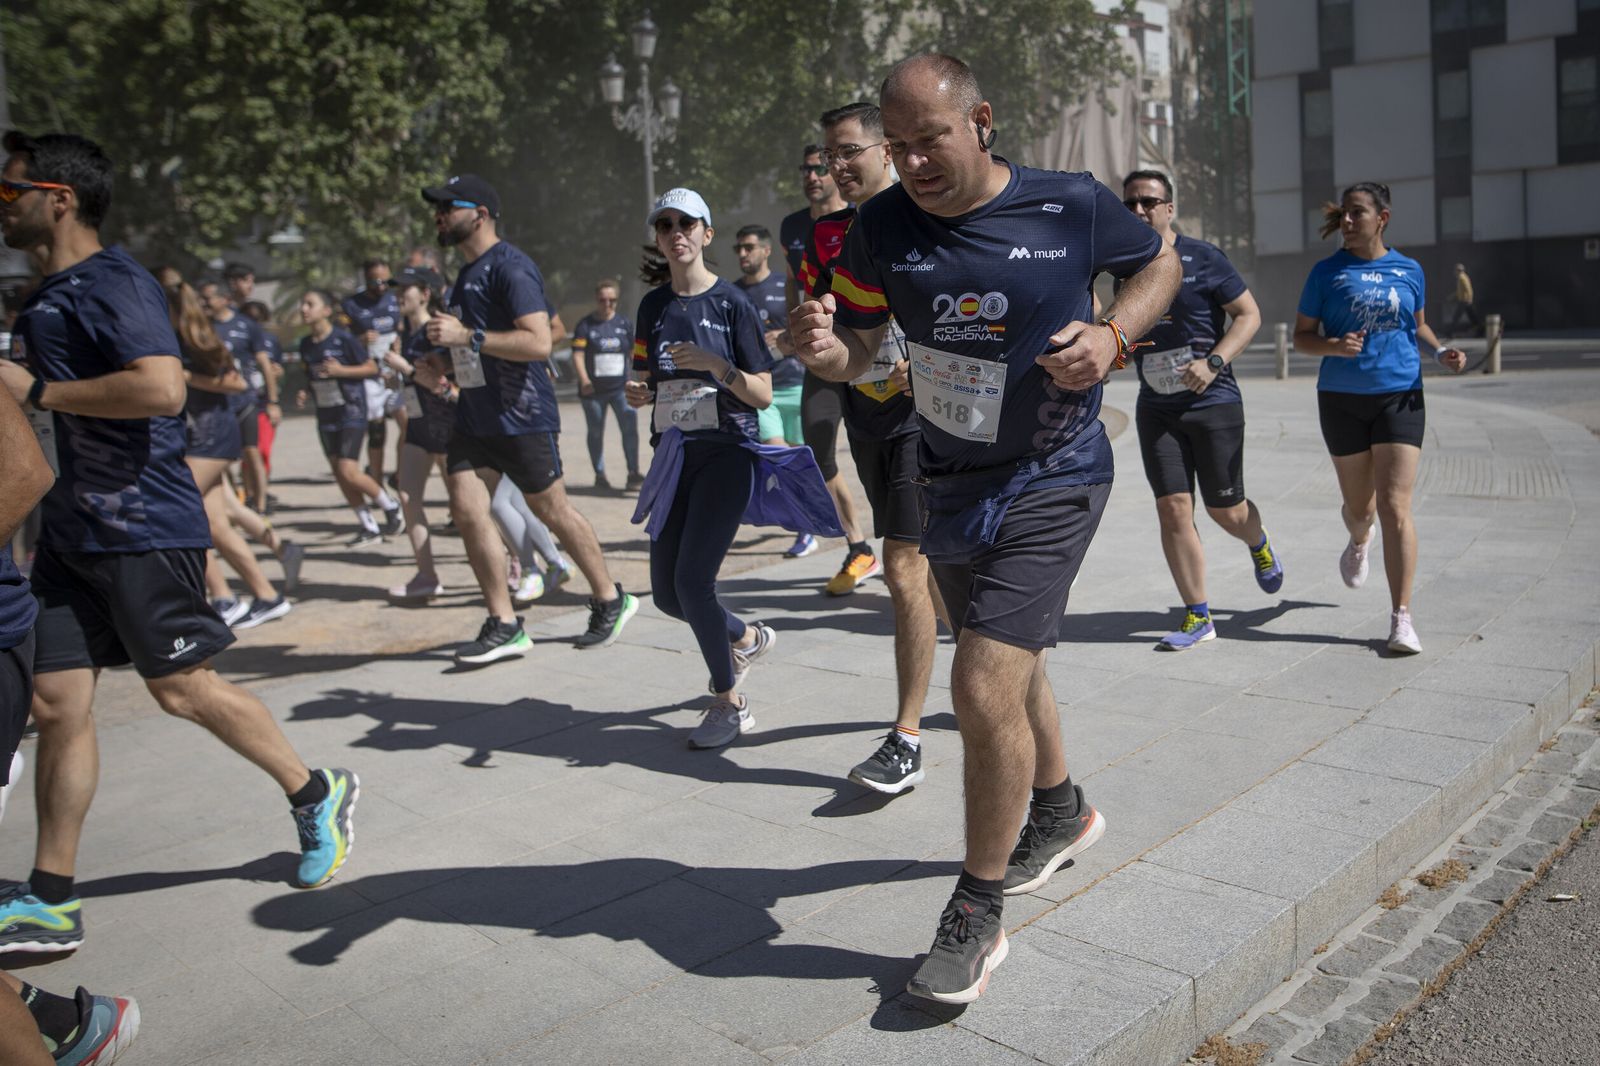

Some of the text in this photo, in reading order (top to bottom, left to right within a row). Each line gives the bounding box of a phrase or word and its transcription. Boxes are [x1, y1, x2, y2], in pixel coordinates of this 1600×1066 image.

[1034, 246, 1067, 260] mupol
[892, 263, 935, 272] Santander
[1361, 271, 1383, 284] edp
[932, 291, 1009, 323] 200
[933, 333, 1004, 341] NACIONAL
[671, 409, 697, 422] 621
[932, 395, 970, 424] 518
